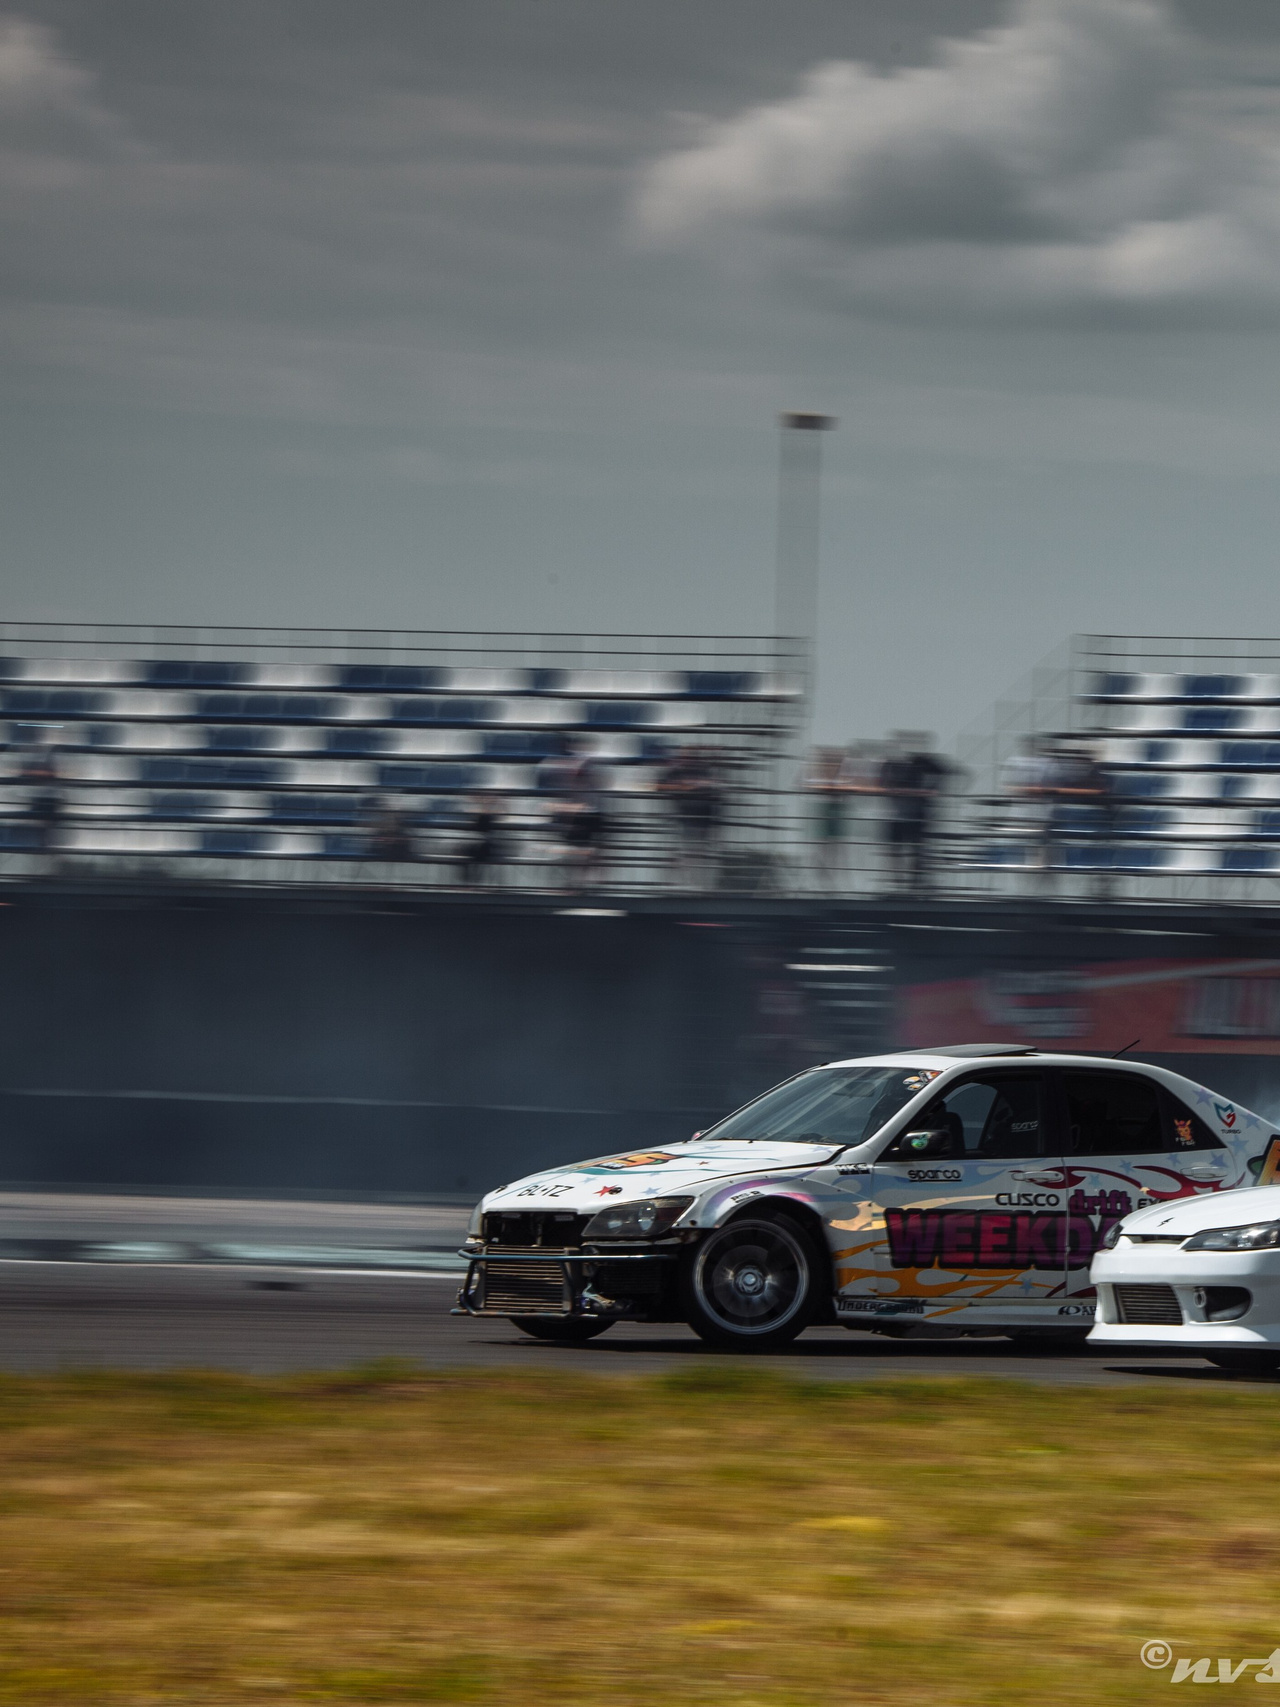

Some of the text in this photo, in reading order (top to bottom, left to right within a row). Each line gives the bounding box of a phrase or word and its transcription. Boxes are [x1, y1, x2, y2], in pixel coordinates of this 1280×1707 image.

[835, 1163, 871, 1175] HKS
[907, 1168, 962, 1182] sparco
[995, 1192, 1060, 1207] CUSCO
[1070, 1189, 1133, 1214] drift
